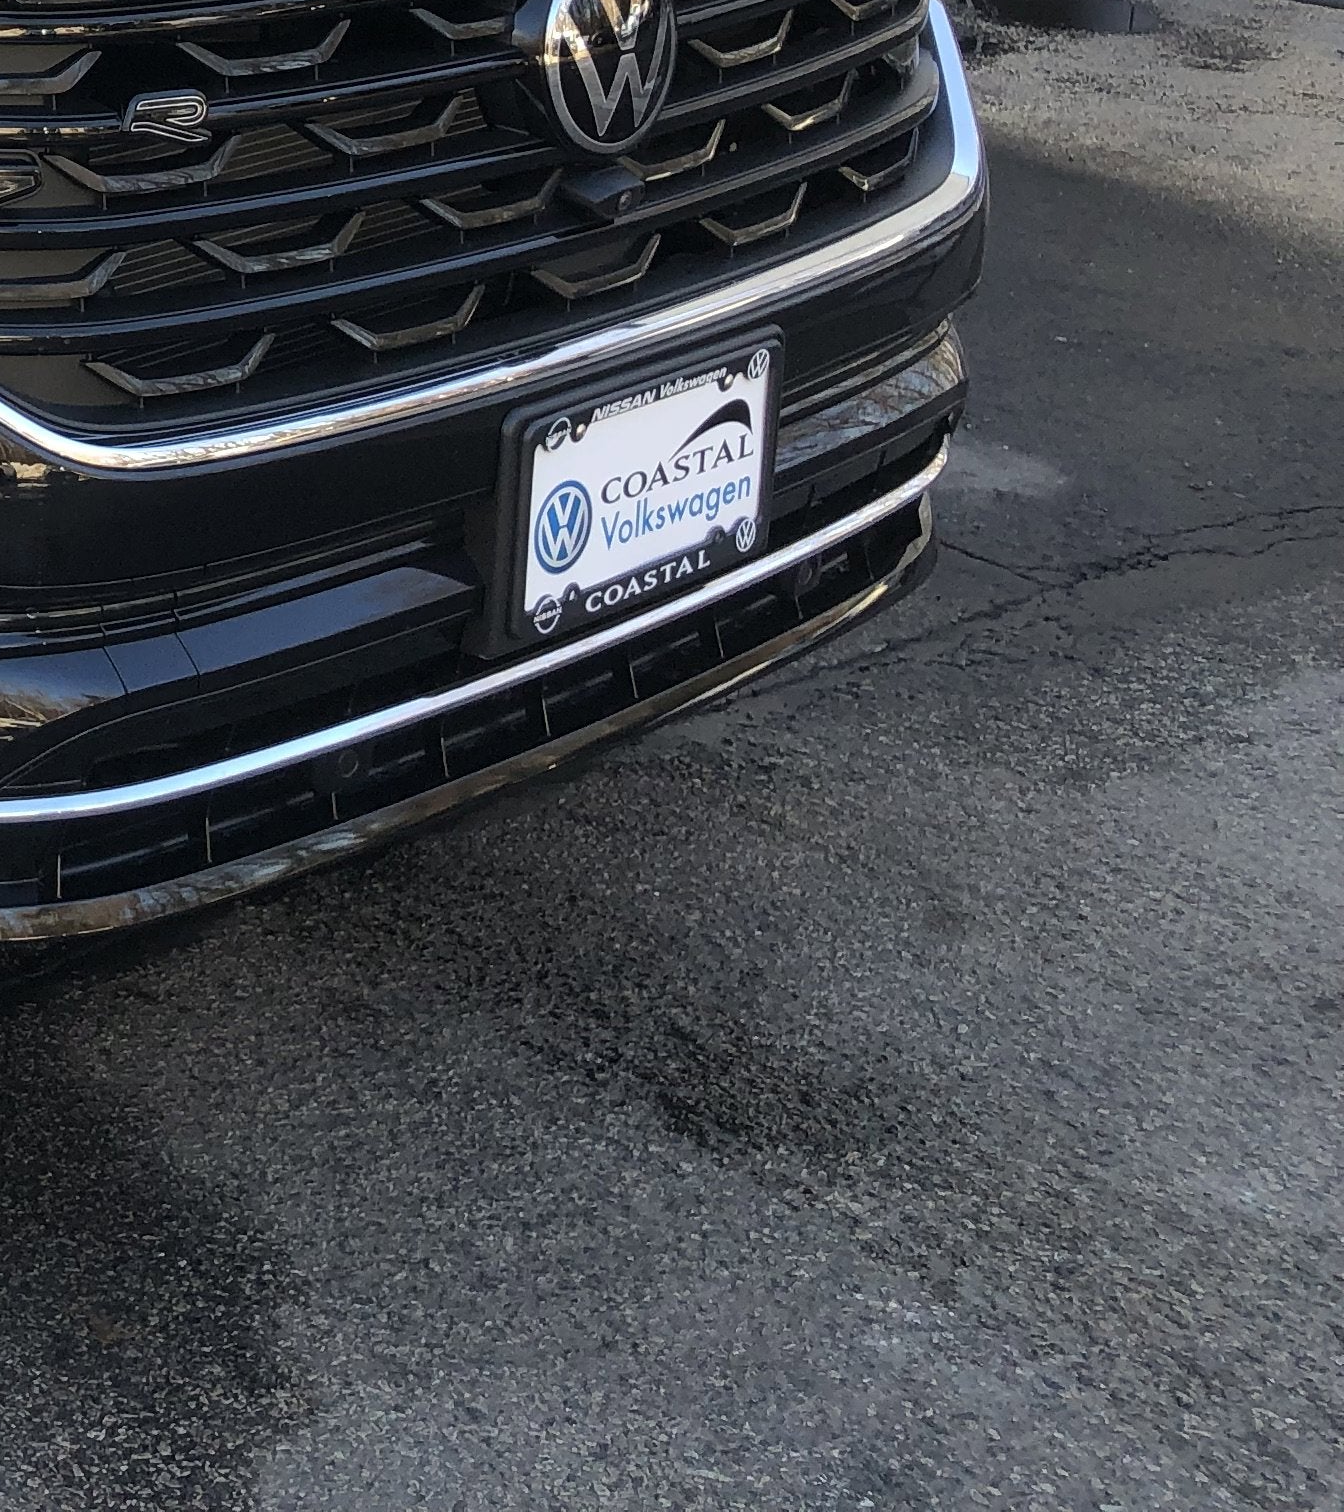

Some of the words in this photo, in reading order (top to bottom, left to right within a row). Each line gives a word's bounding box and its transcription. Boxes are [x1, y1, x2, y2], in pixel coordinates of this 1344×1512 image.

[591, 389, 657, 423] NISSAN
[659, 366, 728, 399] Volkswagen
[600, 433, 755, 506] COASTAL
[600, 474, 752, 551] Volkswagen
[584, 548, 712, 614] COASTAL
